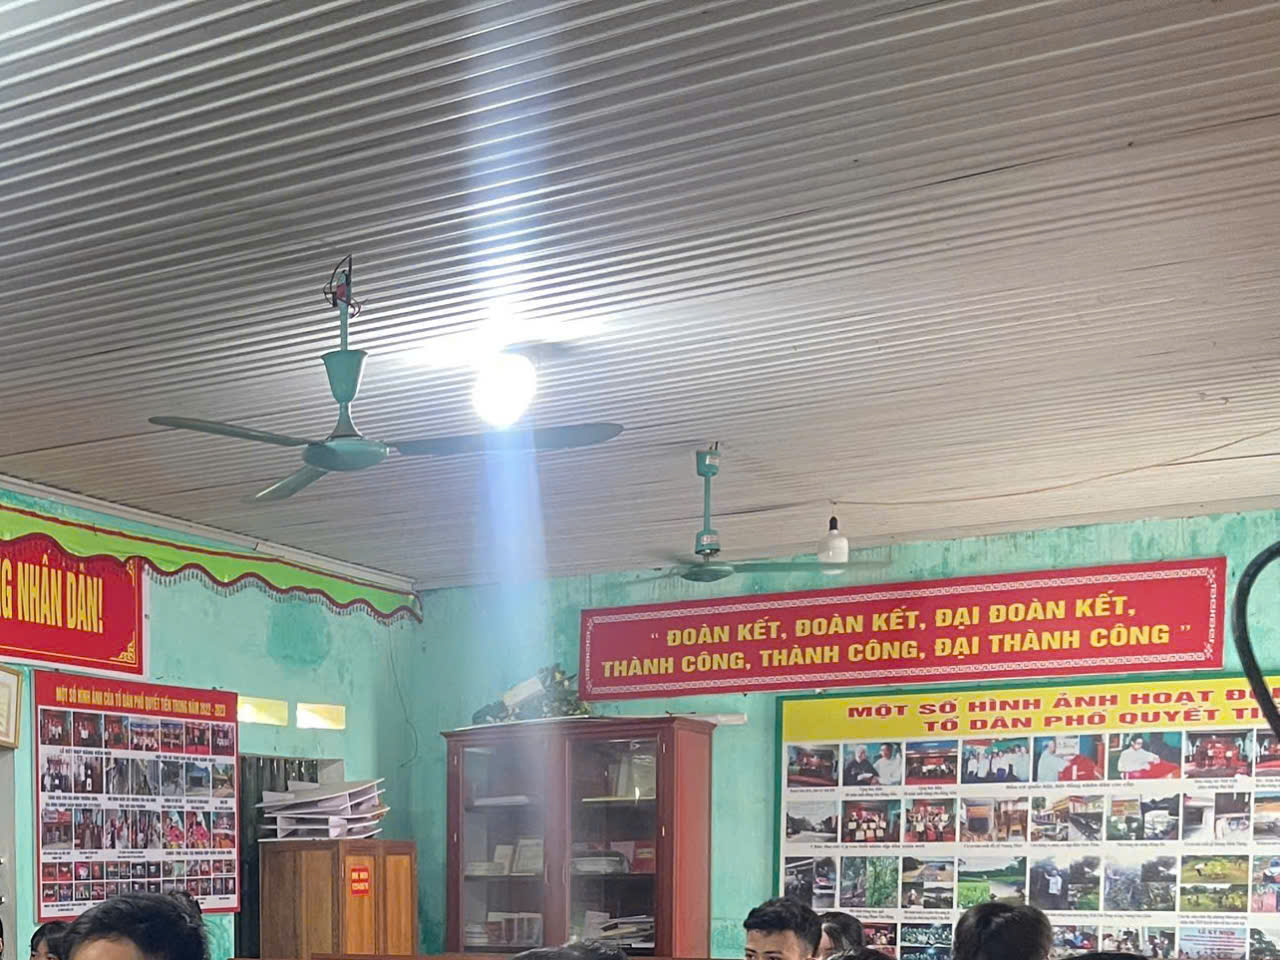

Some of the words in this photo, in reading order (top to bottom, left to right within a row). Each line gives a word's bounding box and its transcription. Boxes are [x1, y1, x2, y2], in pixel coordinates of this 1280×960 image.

[17, 555, 63, 628] NHÂN
[667, 623, 730, 646] ĐOÀN
[737, 616, 787, 642] KẾT,
[795, 611, 863, 637] ĐOÀN
[871, 605, 926, 632] KẾT,
[935, 606, 980, 629] ĐẠI
[989, 598, 1066, 623] ĐOÀN
[1075, 590, 1136, 617] KẾT,
[601, 653, 674, 677] THÀNH
[681, 651, 751, 672] CÔNG,
[760, 643, 839, 667] THÀNH
[847, 639, 926, 662] CÔNG,
[935, 636, 980, 659] ĐẠI
[989, 629, 1080, 653] THÀNH
[1090, 623, 1170, 647] CÔNG
[847, 703, 908, 719] MỘT
[919, 697, 958, 715] SỐ
[969, 697, 1041, 712] HÌNH
[1052, 692, 1118, 708] ẢNH
[1130, 690, 1215, 705] HOẠT
[970, 715, 1032, 731] DÂN
[1044, 709, 1107, 728] PHỐ
[1119, 705, 1220, 724] QUYẾT
